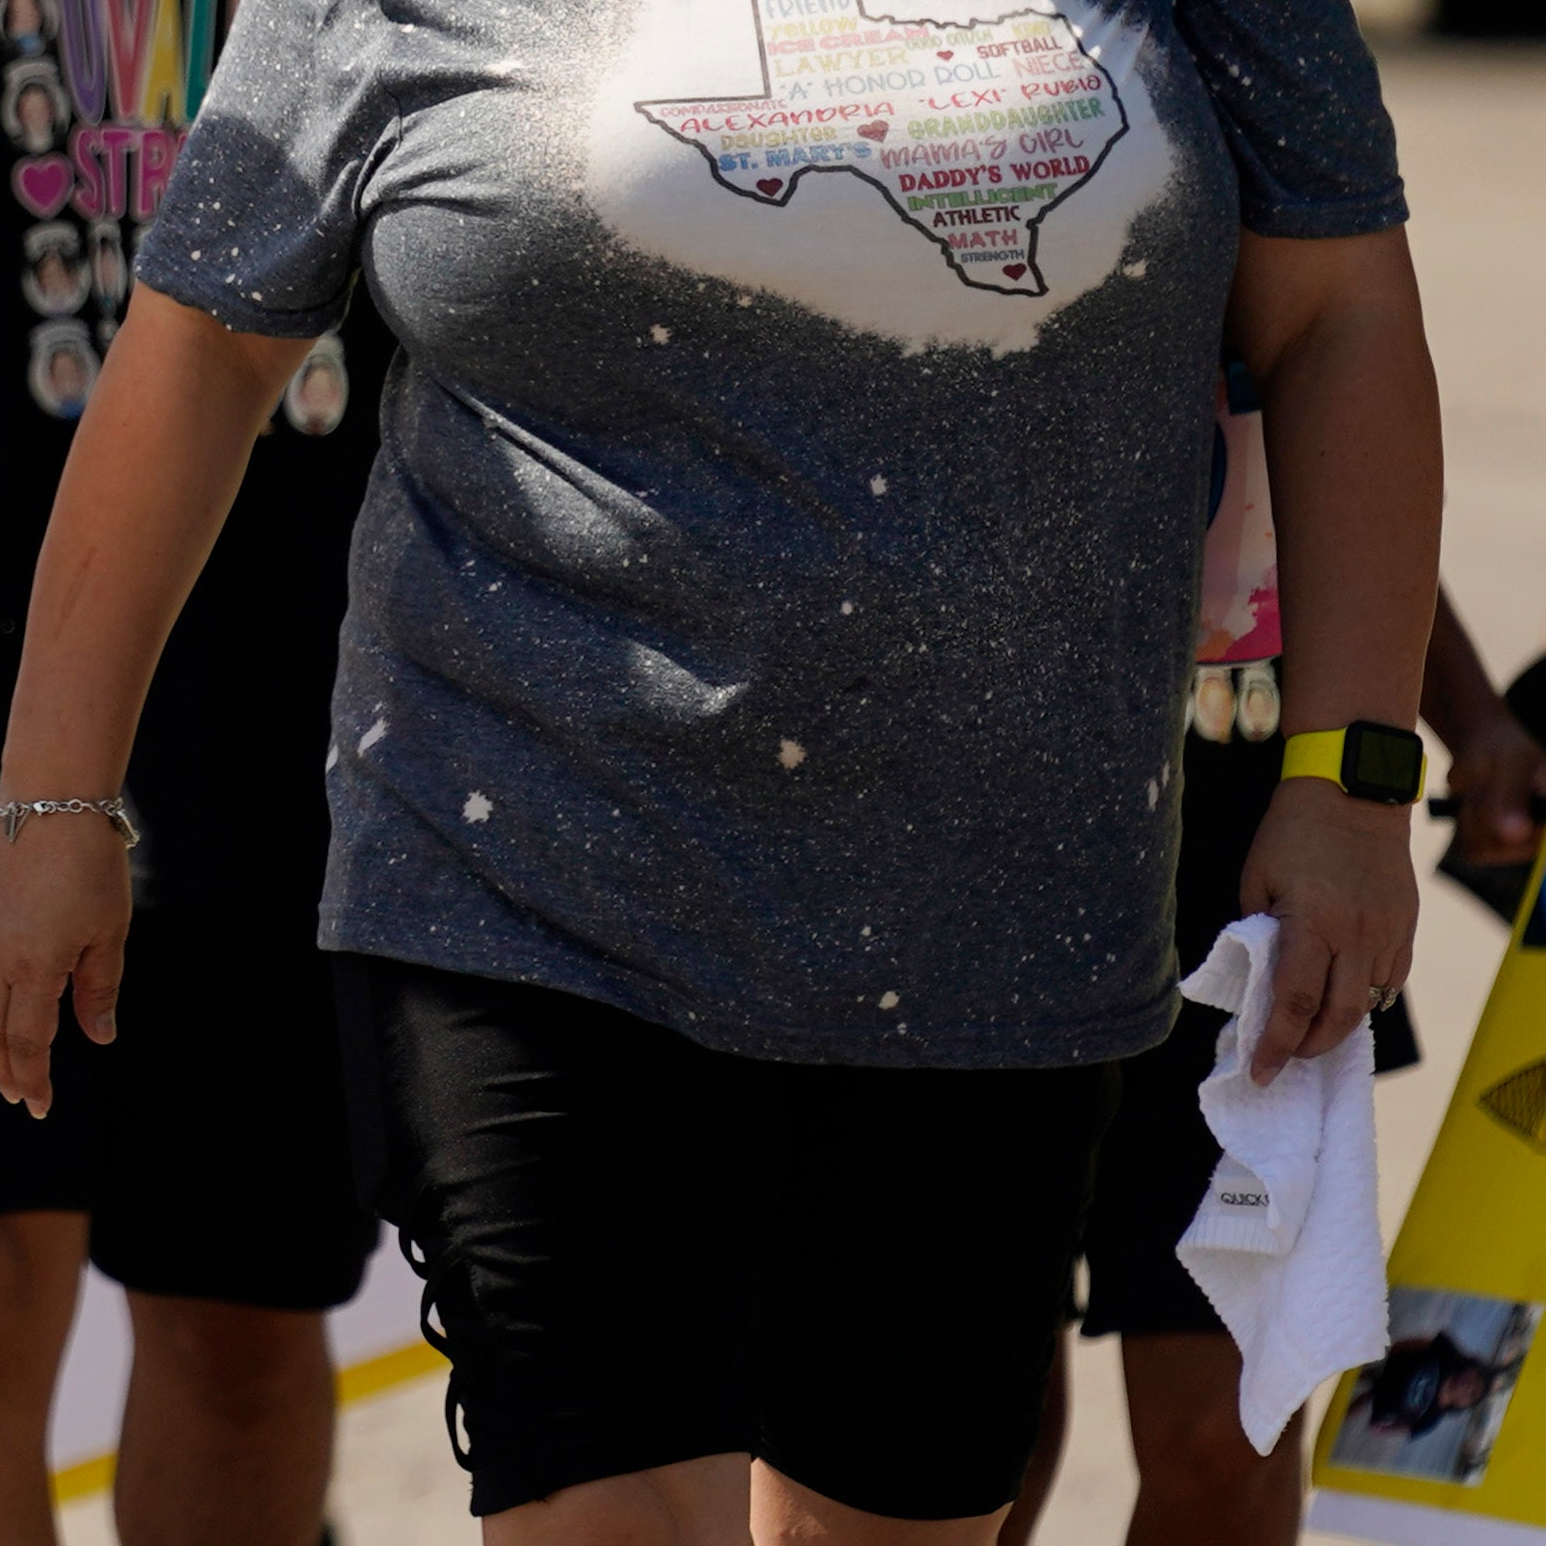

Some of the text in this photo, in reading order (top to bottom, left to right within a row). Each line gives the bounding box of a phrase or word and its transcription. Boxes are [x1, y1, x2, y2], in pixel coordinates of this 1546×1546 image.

[767, 25, 929, 56] ICE CREAM
[976, 36, 1062, 60] SOFTBALL
[774, 47, 909, 78] LAWYER
[1012, 51, 1085, 78] NIECE
[822, 70, 925, 97] HONOR
[934, 60, 1000, 86] ROLL
[680, 101, 895, 133] ALEXANDRIA
[1021, 75, 1101, 100] RUBIO
[908, 97, 1105, 140] GRANDDAUGHTER
[720, 126, 837, 150] DAUGHTER
[880, 128, 1084, 169] MAMA'S GIRL
[70, 124, 192, 220] STR
[718, 141, 872, 172] ST. MARY'S
[898, 155, 1090, 192] DADDY'S WORLD
[907, 183, 1058, 212] INTELLIGENT
[933, 206, 1021, 227] ATHLETIC
[947, 229, 1018, 250] MATH
[961, 249, 1025, 264] STRENGTH
